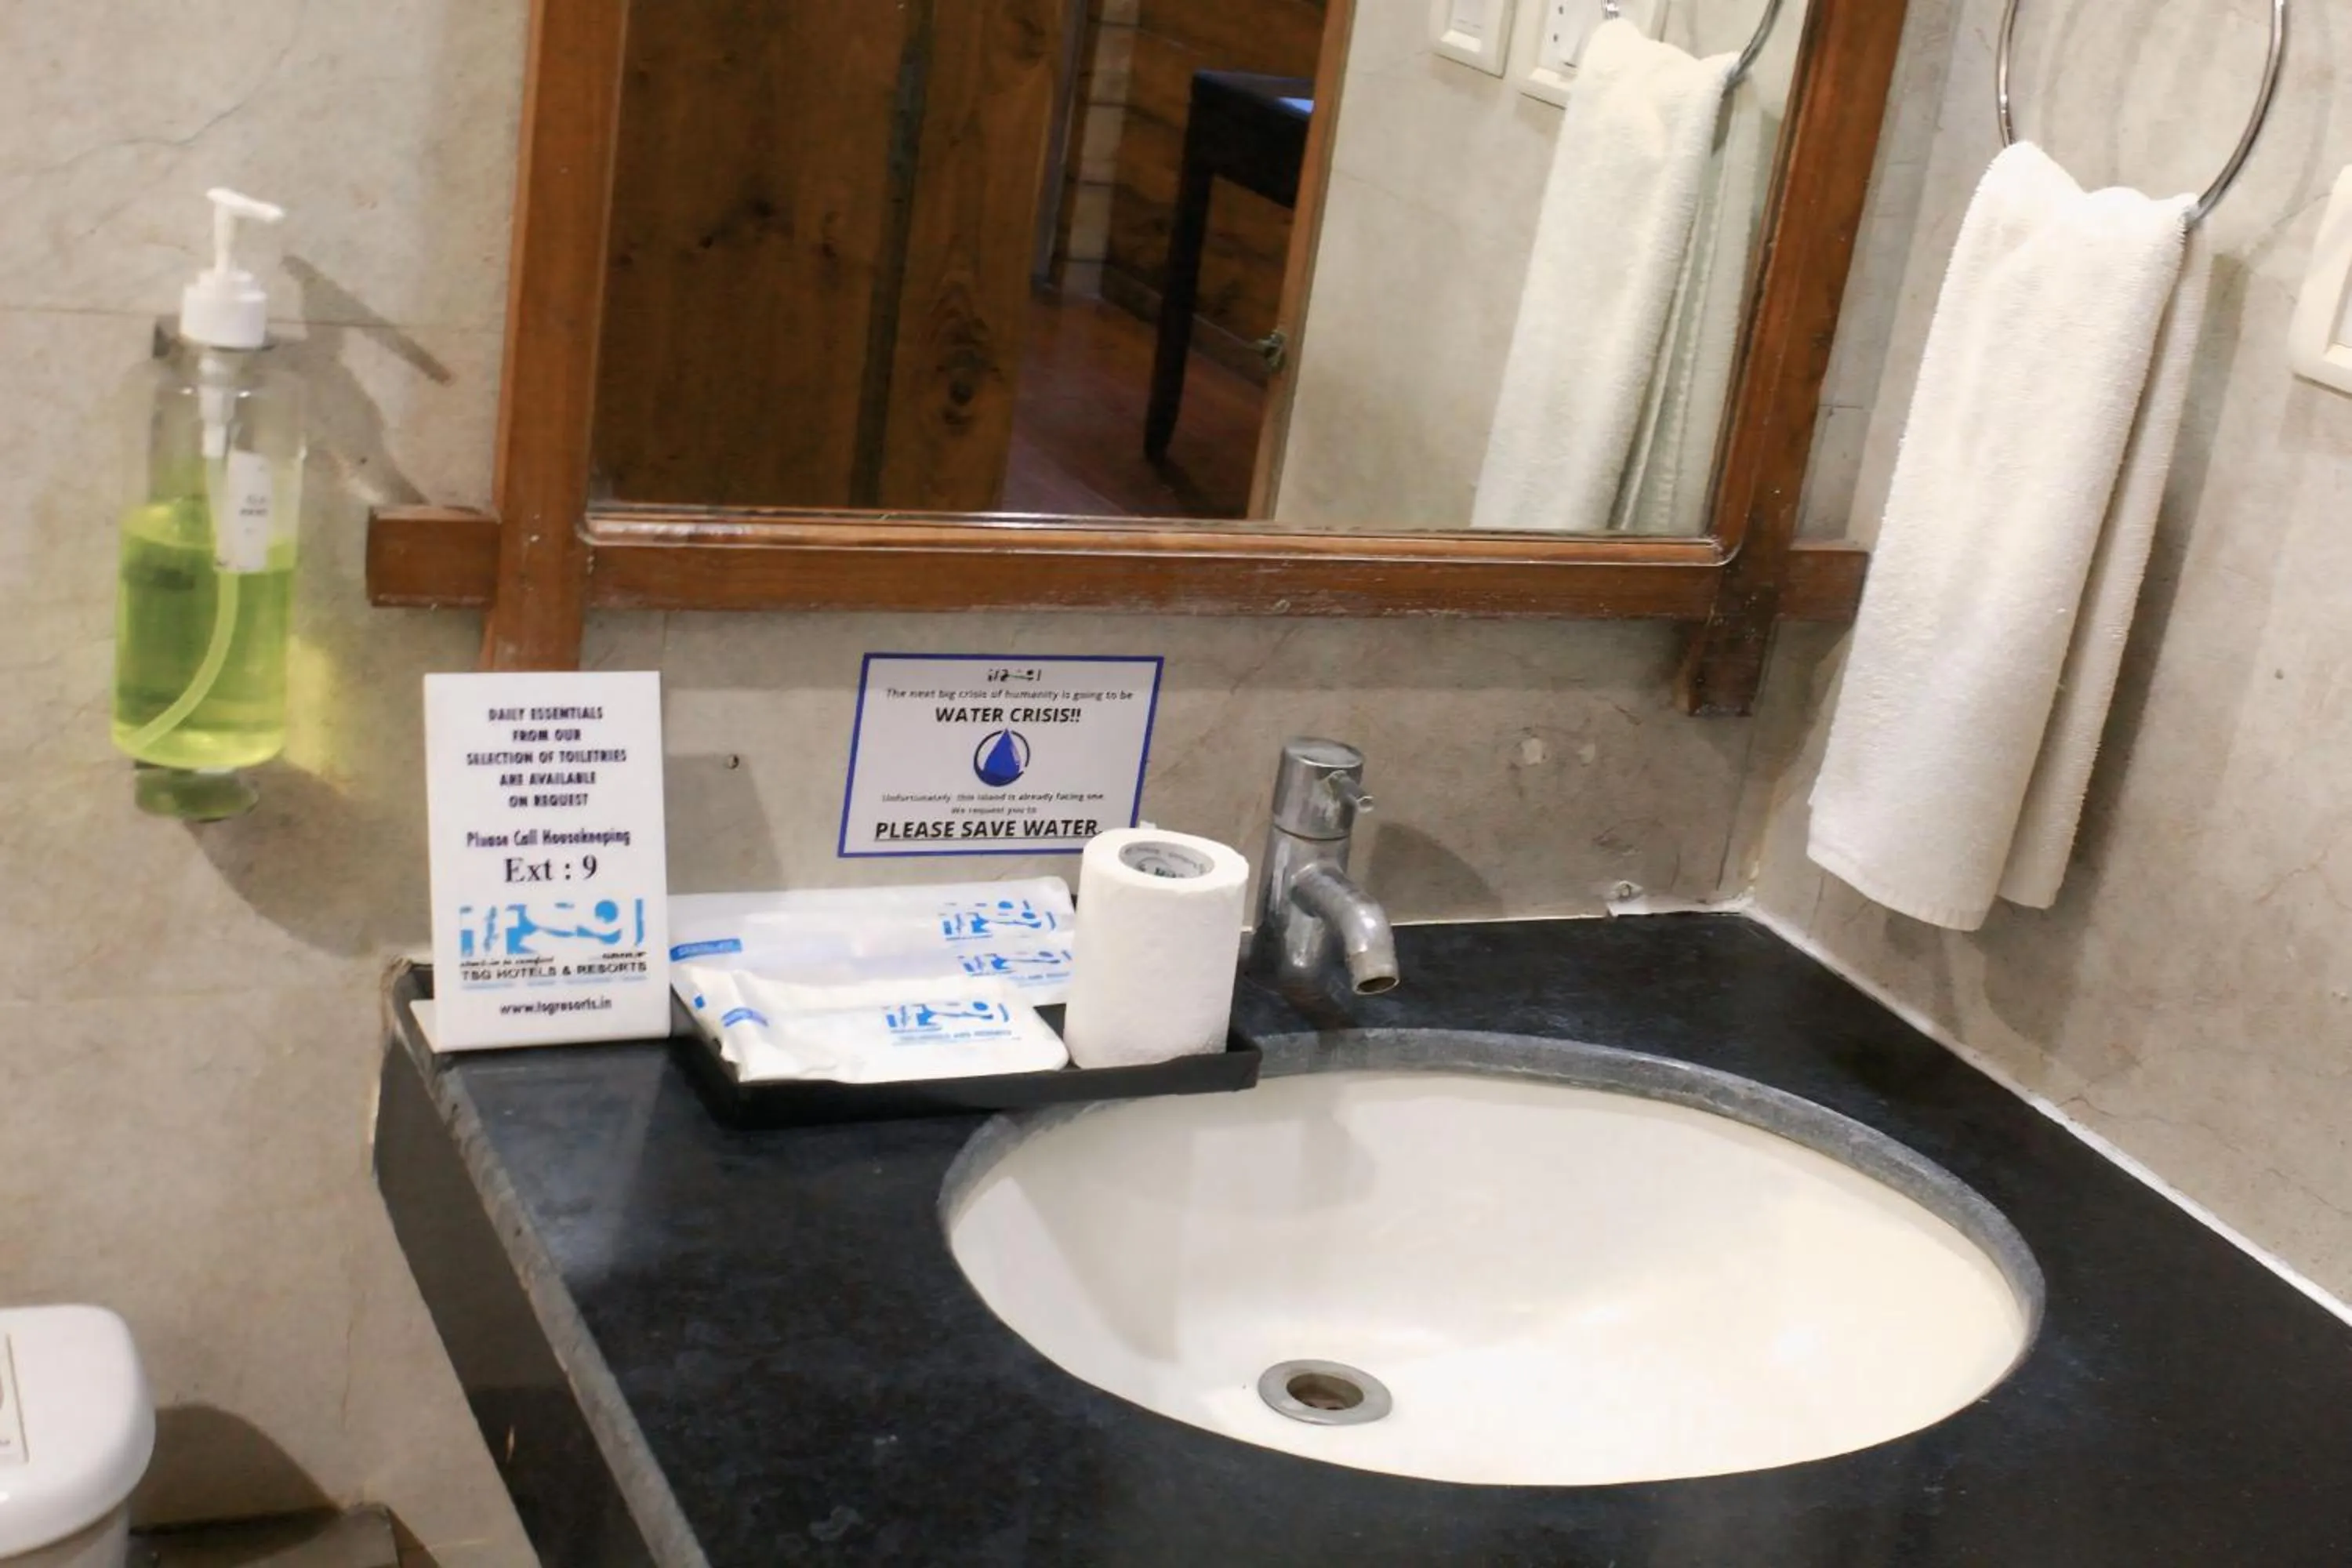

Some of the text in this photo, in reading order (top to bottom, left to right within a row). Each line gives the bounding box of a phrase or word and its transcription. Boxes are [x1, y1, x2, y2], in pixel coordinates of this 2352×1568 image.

[991, 689, 1003, 698] of
[1105, 691, 1117, 699] to
[1119, 690, 1134, 699] be
[488, 706, 603, 720] DAILY ESSENTIALS
[935, 707, 1081, 722] WATER CRISIS!!
[513, 728, 581, 741] FROM OUR
[466, 749, 626, 765] SELECTION OF TOILETRIES
[499, 771, 596, 786] ARE AVAILABLE
[510, 793, 589, 808] ON REQUEST
[875, 821, 955, 838] PLEASE
[961, 820, 1017, 837] SAVE
[466, 829, 630, 848] Please Call Housekeeping
[504, 856, 553, 882] Ext
[583, 855, 597, 878] 9
[496, 966, 557, 978] HOTELS
[561, 965, 572, 975] &
[576, 961, 647, 975] RESORTS
